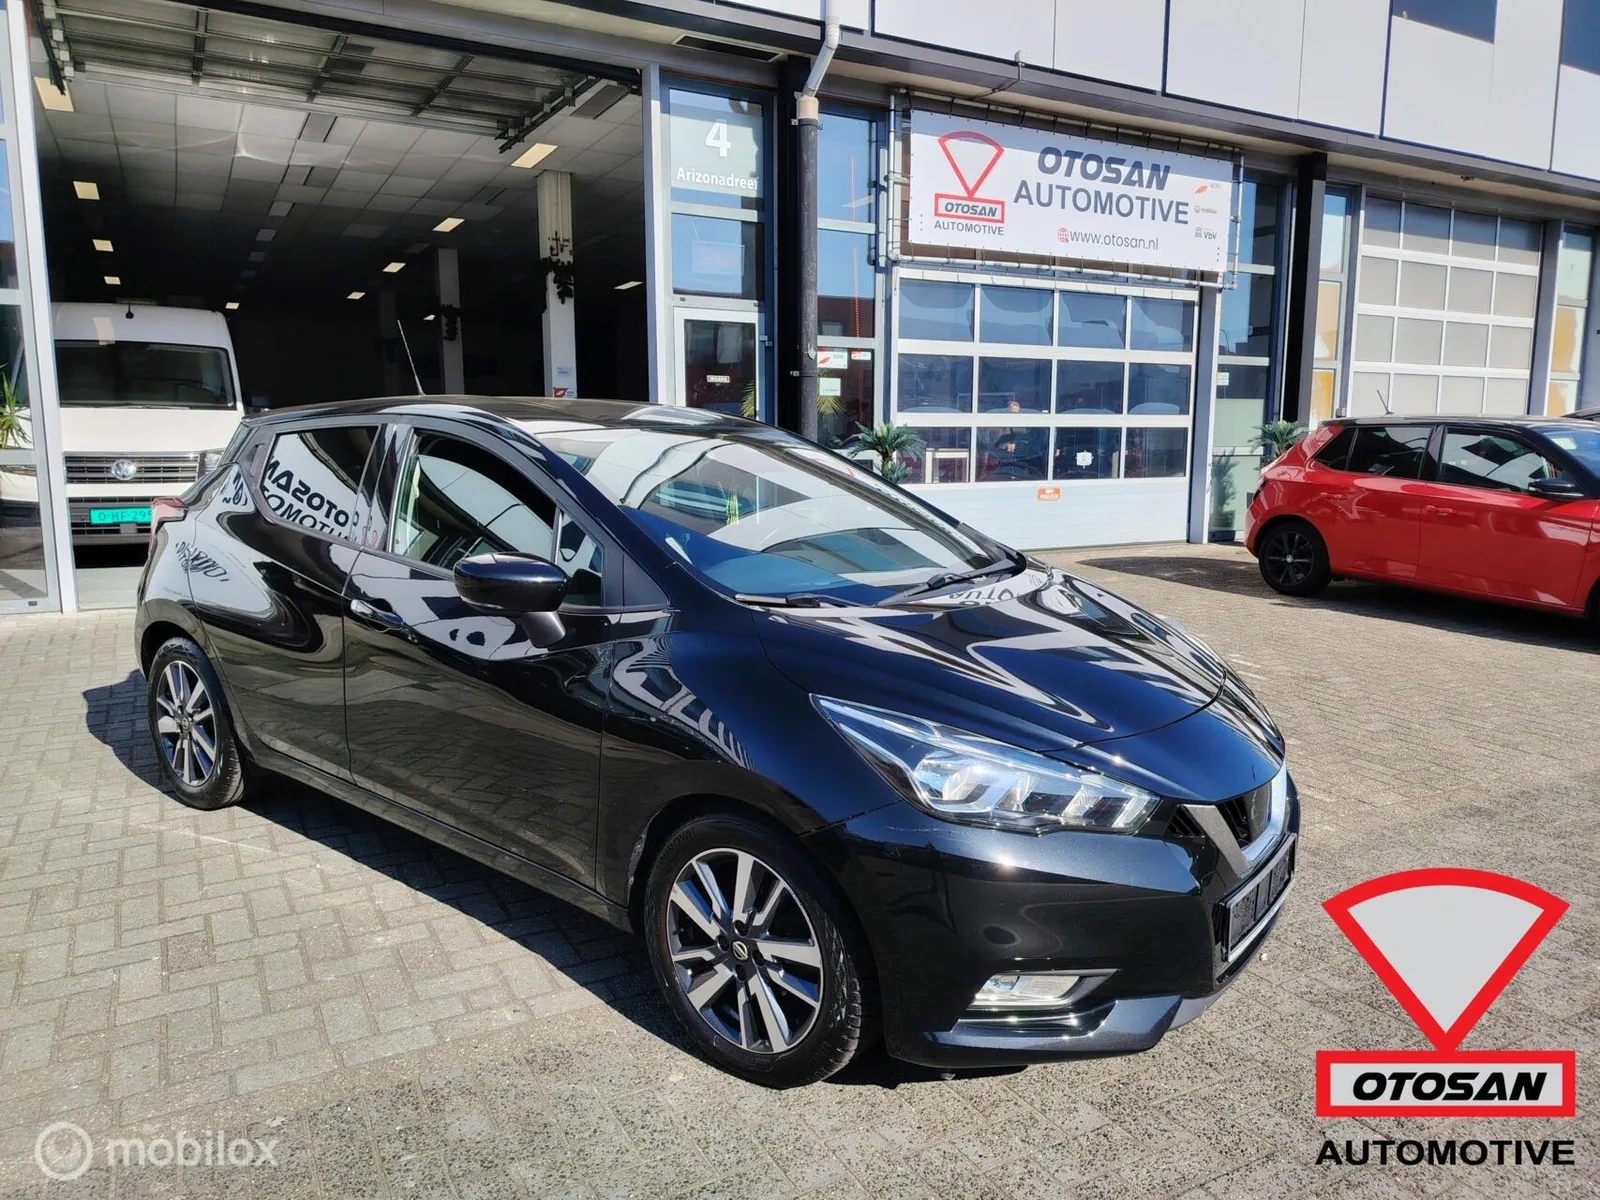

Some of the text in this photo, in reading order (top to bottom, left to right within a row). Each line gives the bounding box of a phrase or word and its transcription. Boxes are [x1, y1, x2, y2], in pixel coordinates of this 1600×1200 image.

[705, 119, 732, 157] 4
[1038, 146, 1171, 191] OTOSAN
[945, 202, 997, 217] OTOSAN
[1013, 180, 1189, 224] AUTOMOTIVE
[934, 220, 1004, 236] AUTOMOTIVE
[1070, 230, 1159, 250] www.otosan.nl
